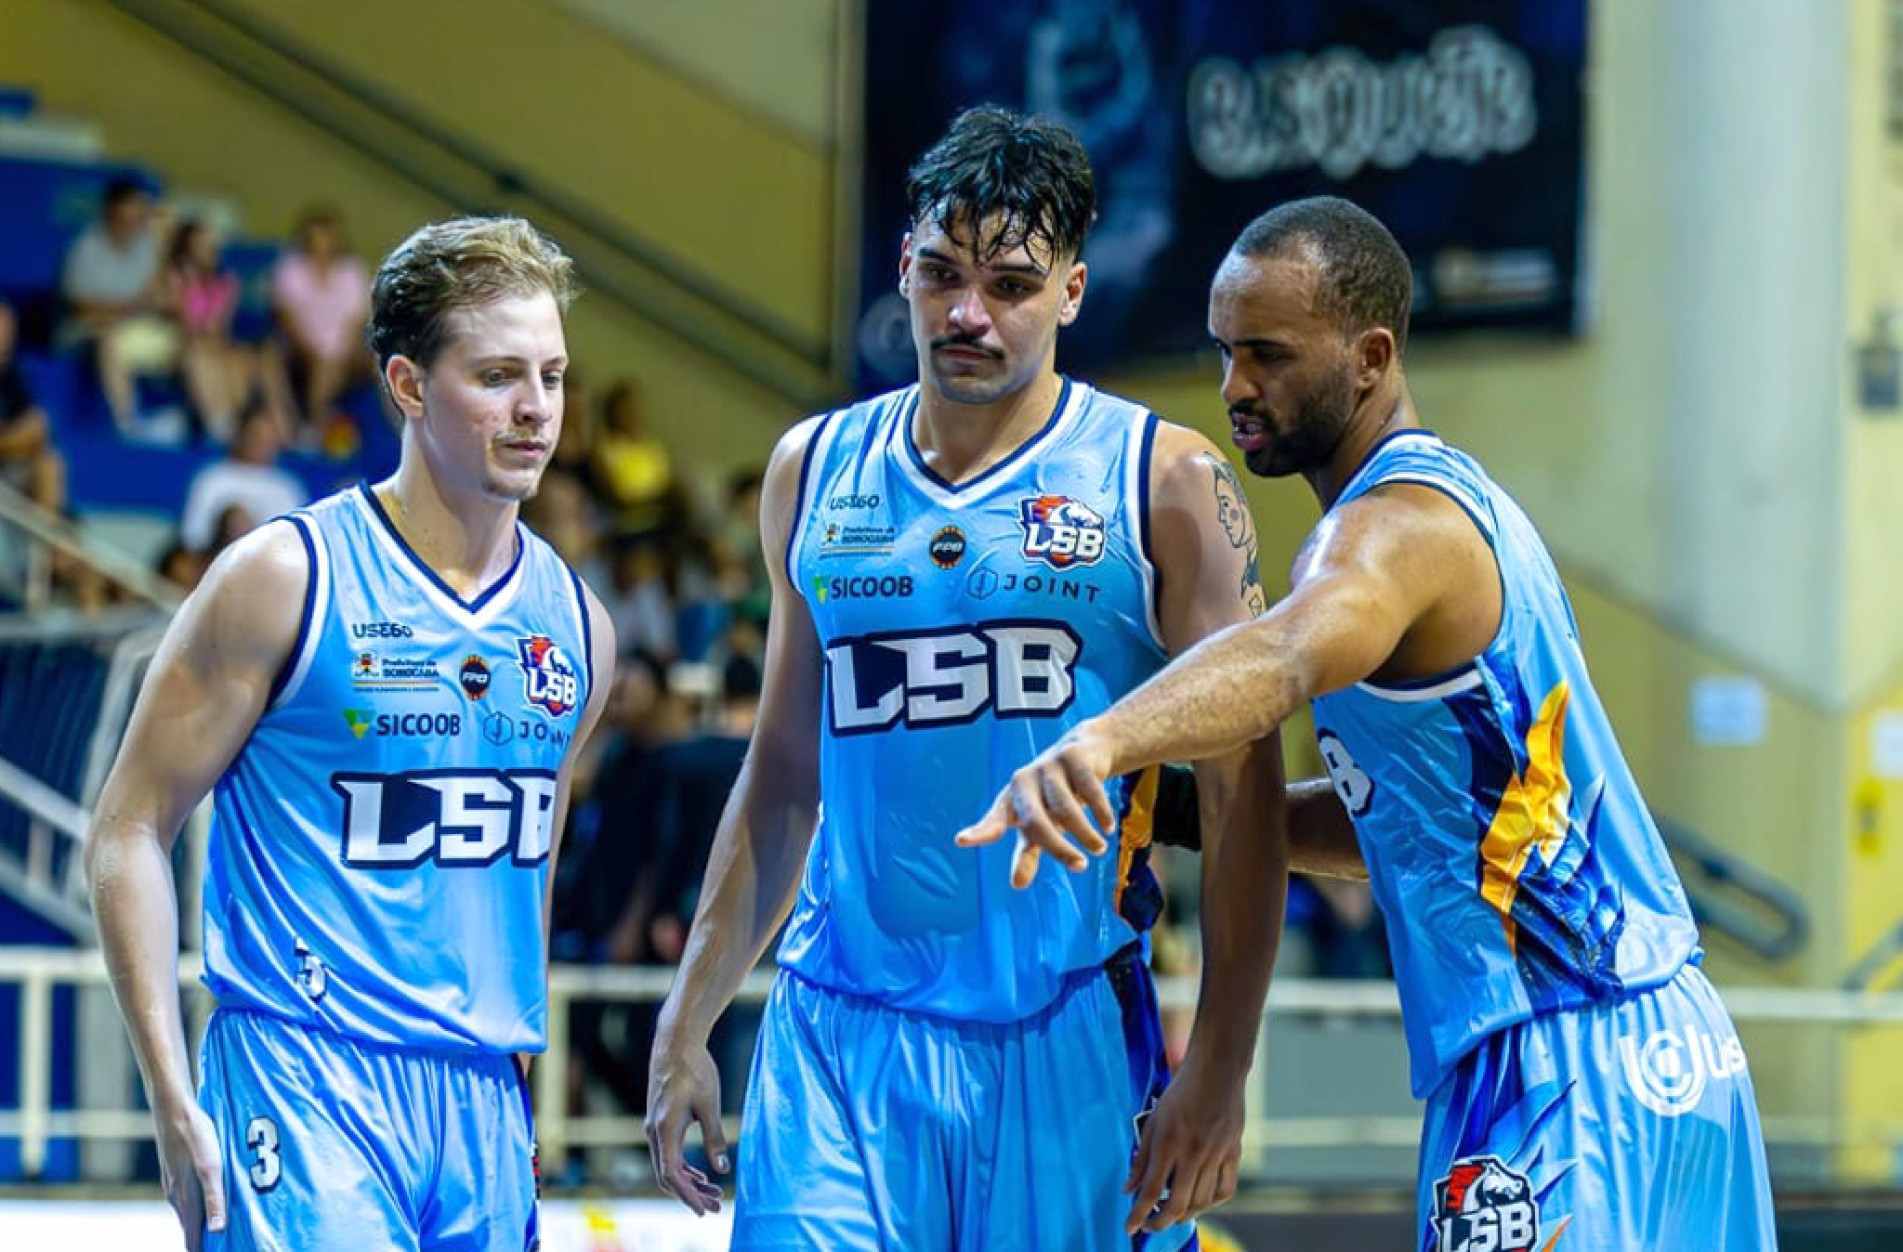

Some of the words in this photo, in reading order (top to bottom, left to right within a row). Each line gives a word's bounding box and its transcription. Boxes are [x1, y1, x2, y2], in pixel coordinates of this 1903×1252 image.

[1025, 523, 1104, 556] LSB
[831, 575, 913, 599] SICOOB
[1004, 574, 1099, 601] JOINT
[529, 668, 576, 705] LSB
[828, 620, 1081, 735] LSB
[376, 714, 461, 736] SICOOB
[246, 1116, 281, 1193] 3
[1439, 1201, 1534, 1252] LSB
